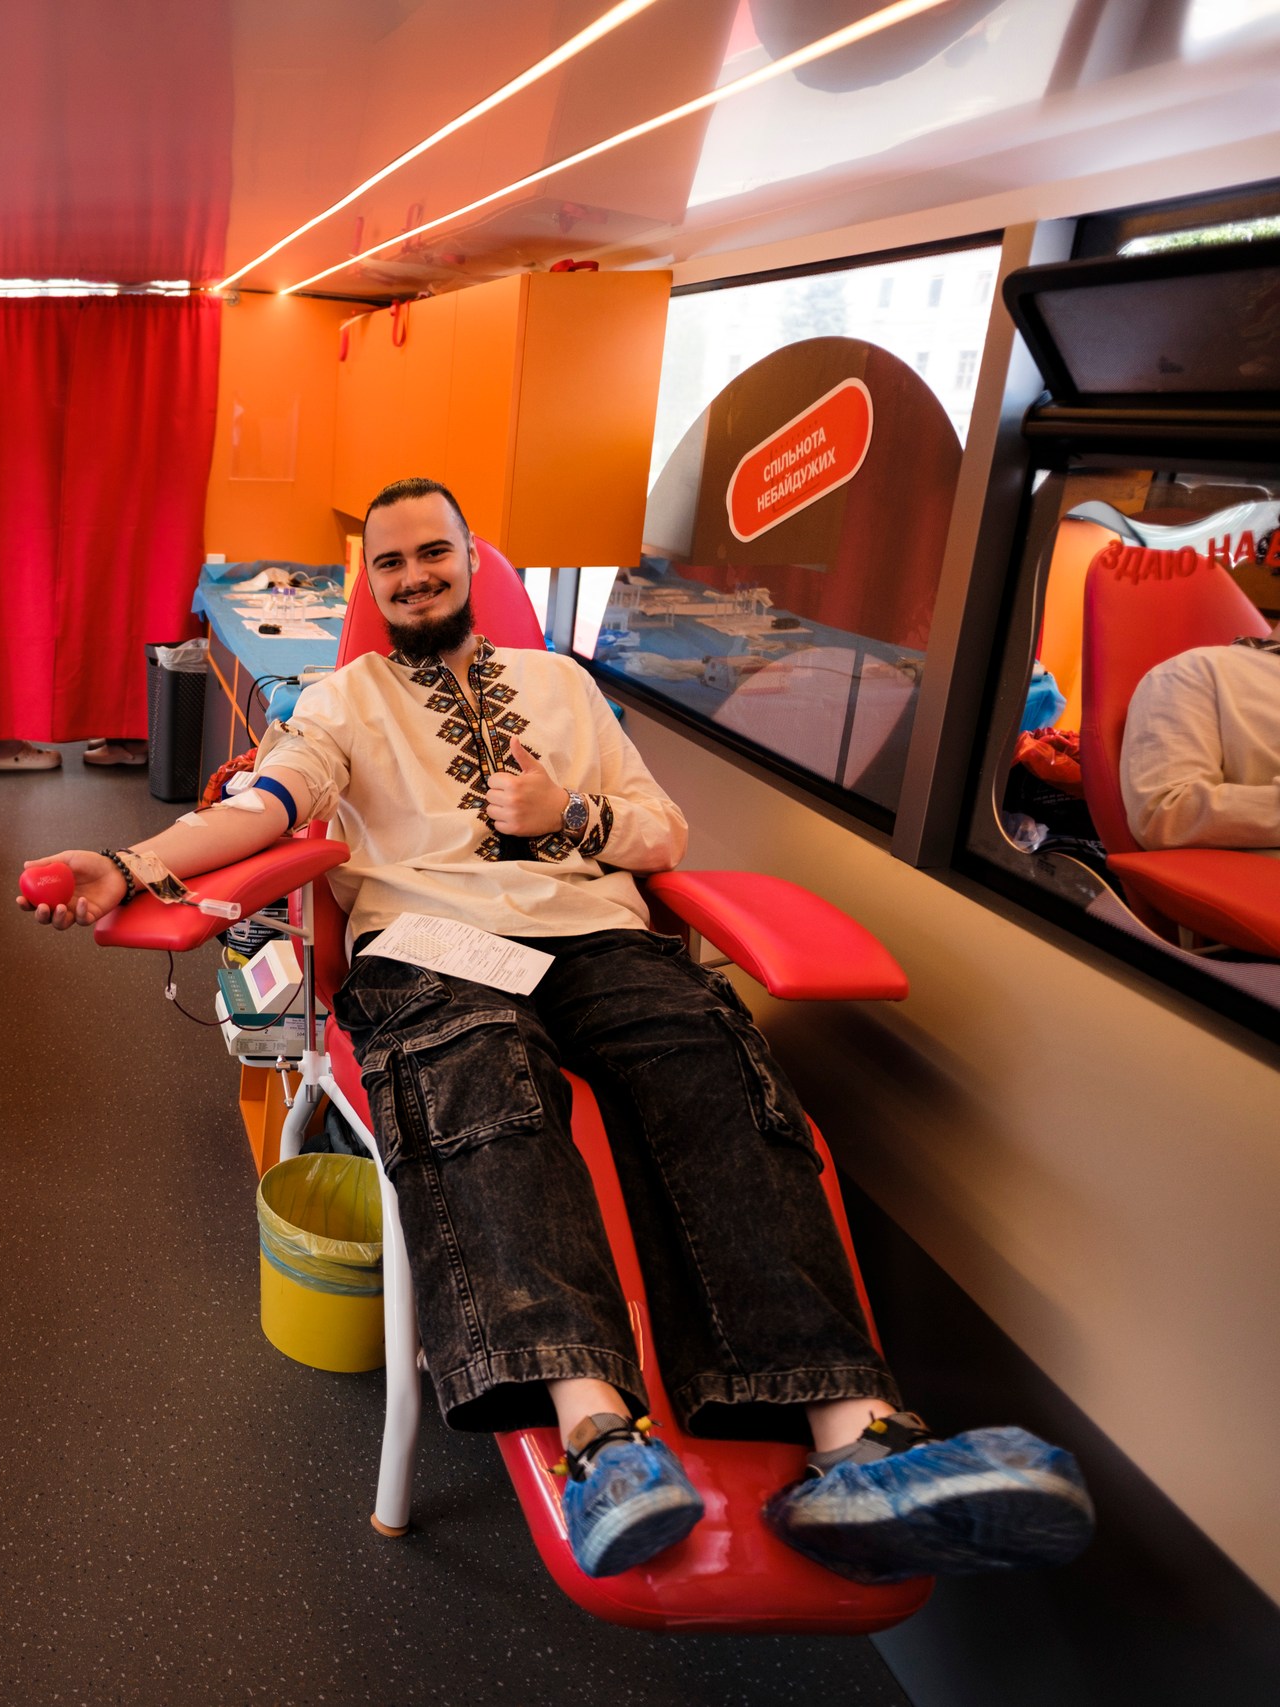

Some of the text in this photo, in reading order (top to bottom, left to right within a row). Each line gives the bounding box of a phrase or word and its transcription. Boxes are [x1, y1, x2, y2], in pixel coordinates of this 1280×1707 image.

[757, 447, 836, 513] НЕБАЙДУЖИХ
[763, 427, 826, 482] СПІЛЬНОТА
[1100, 539, 1198, 585] ЗДАЮ
[1207, 530, 1255, 569] НА
